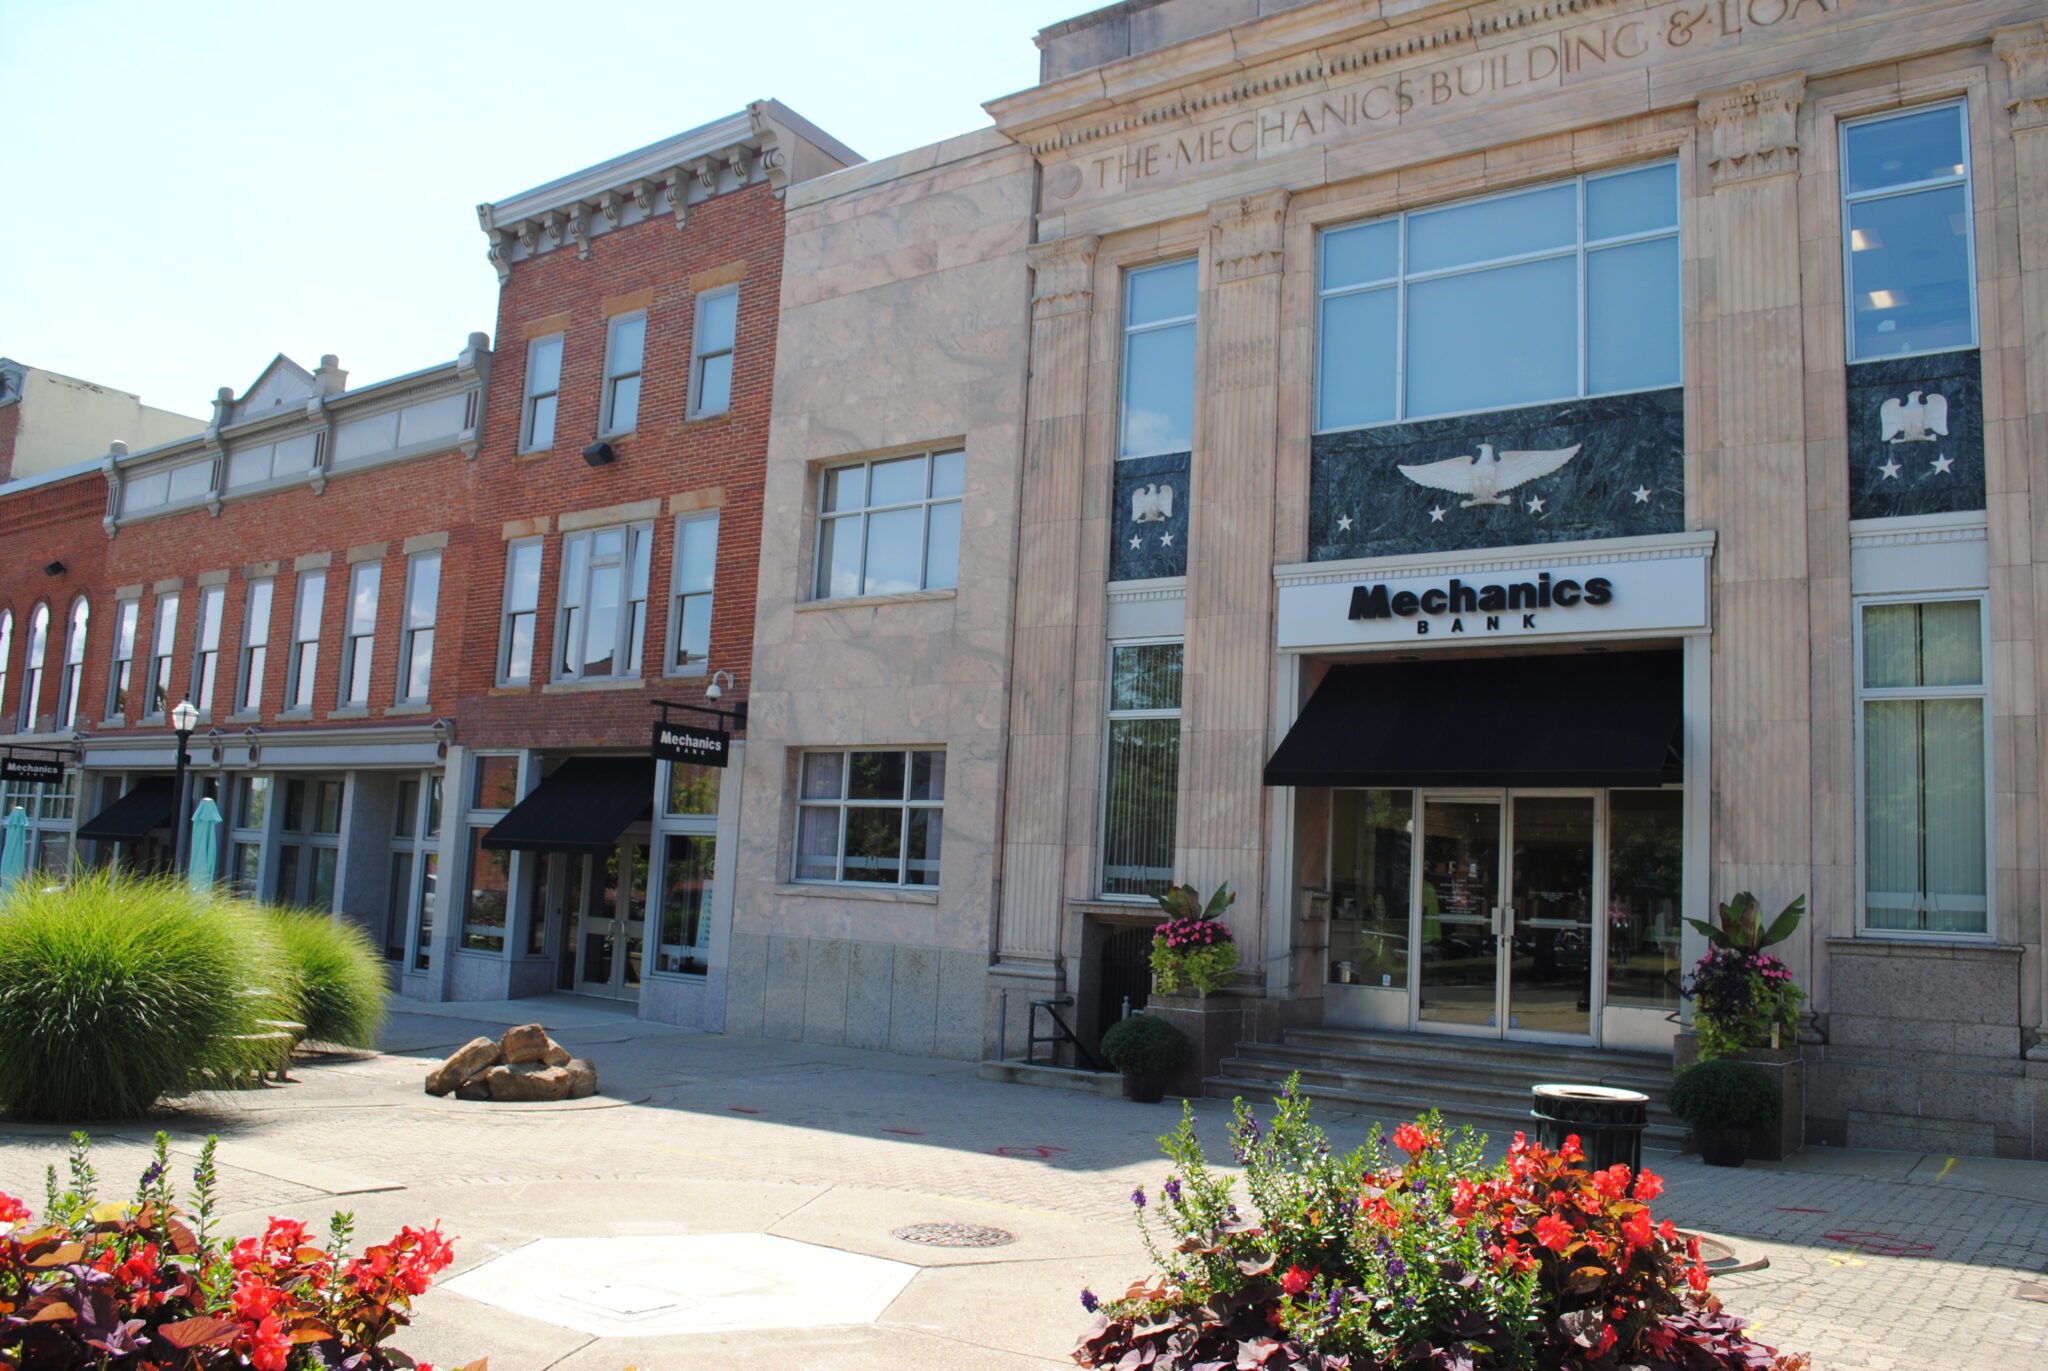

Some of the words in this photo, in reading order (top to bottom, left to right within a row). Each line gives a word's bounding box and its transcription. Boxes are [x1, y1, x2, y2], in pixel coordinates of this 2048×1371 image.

[1091, 143, 1161, 189] THE
[1174, 79, 1414, 170] MECHANICS
[1430, 20, 1650, 106] BUILDING
[1666, 4, 1708, 47] &
[1347, 571, 1614, 621] Mechanics
[1416, 613, 1537, 636] BANK
[660, 730, 722, 751] Mechanics
[676, 746, 705, 755] BANK
[7, 762, 58, 774] Mechanics
